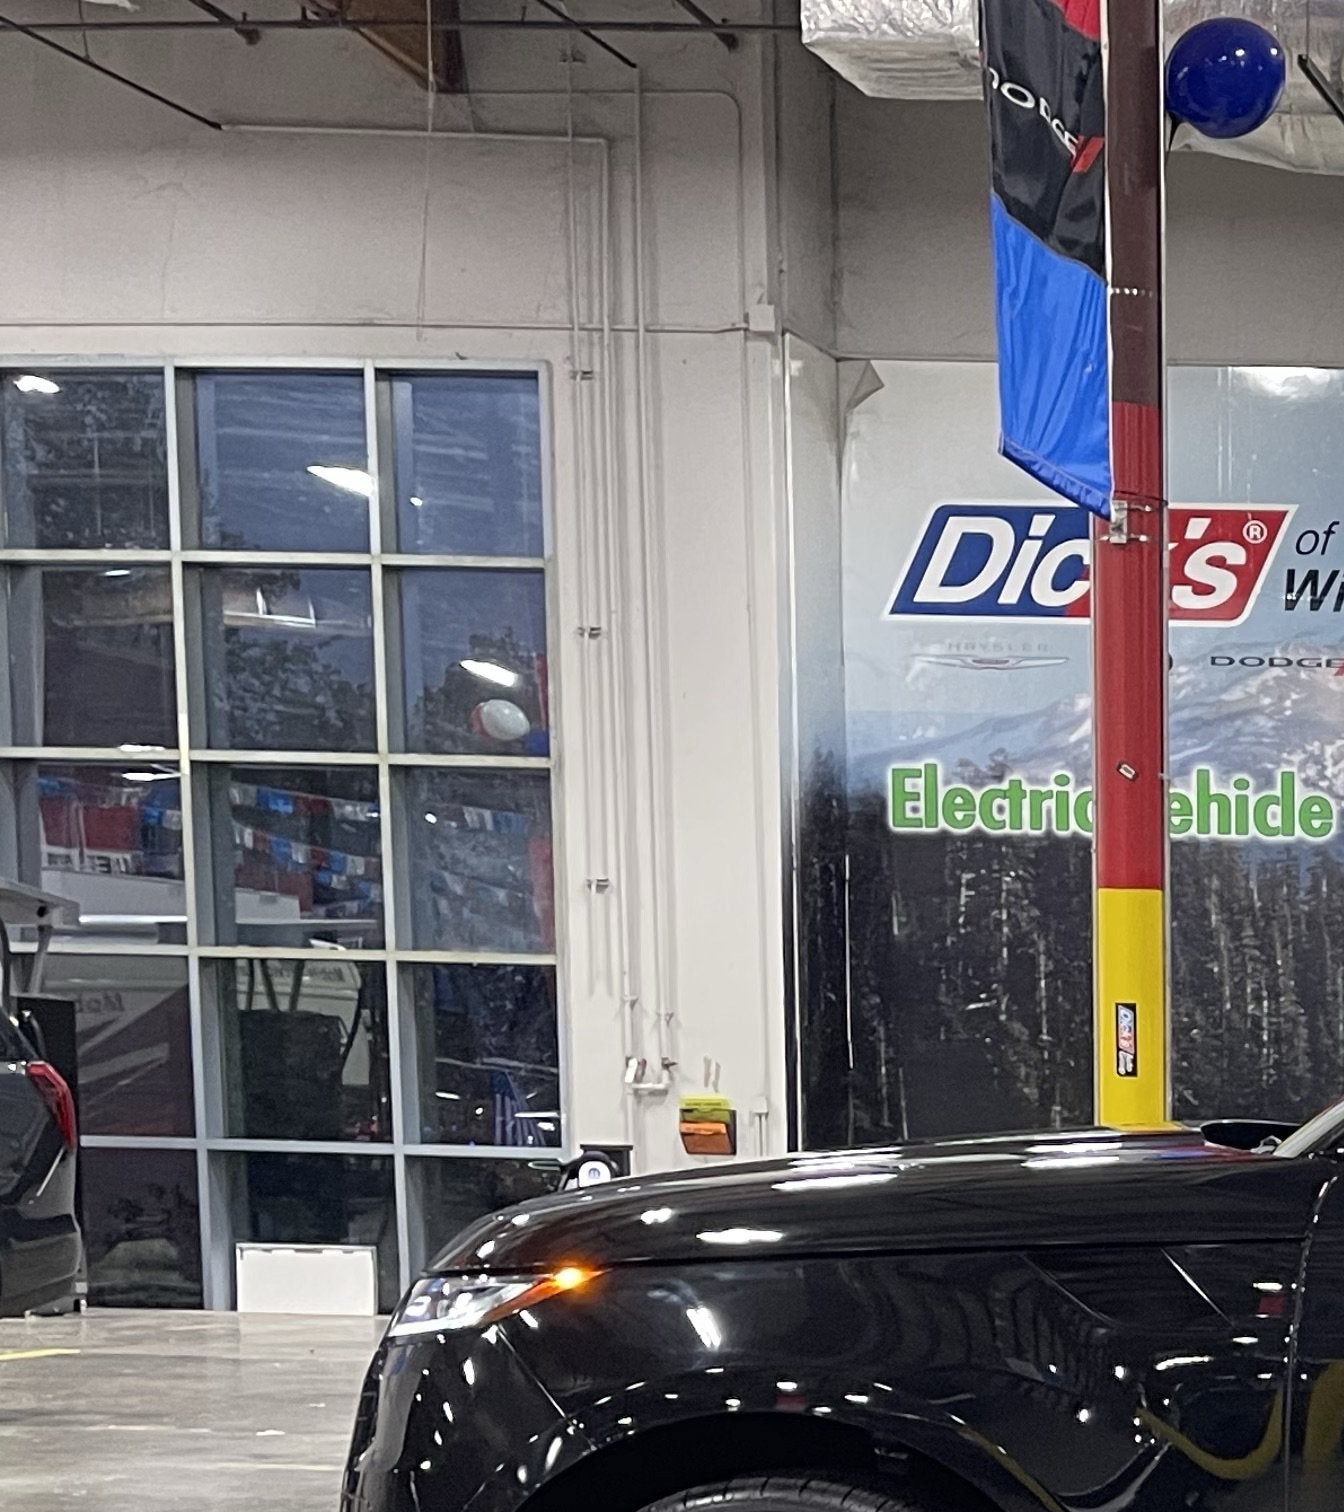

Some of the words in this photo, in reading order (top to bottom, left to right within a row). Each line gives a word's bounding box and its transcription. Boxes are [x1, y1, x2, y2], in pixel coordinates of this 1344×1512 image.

[912, 514, 1247, 609] Dic's
[1295, 521, 1340, 556] of
[891, 763, 1093, 831] Electric
[1168, 769, 1333, 837] ehicle
